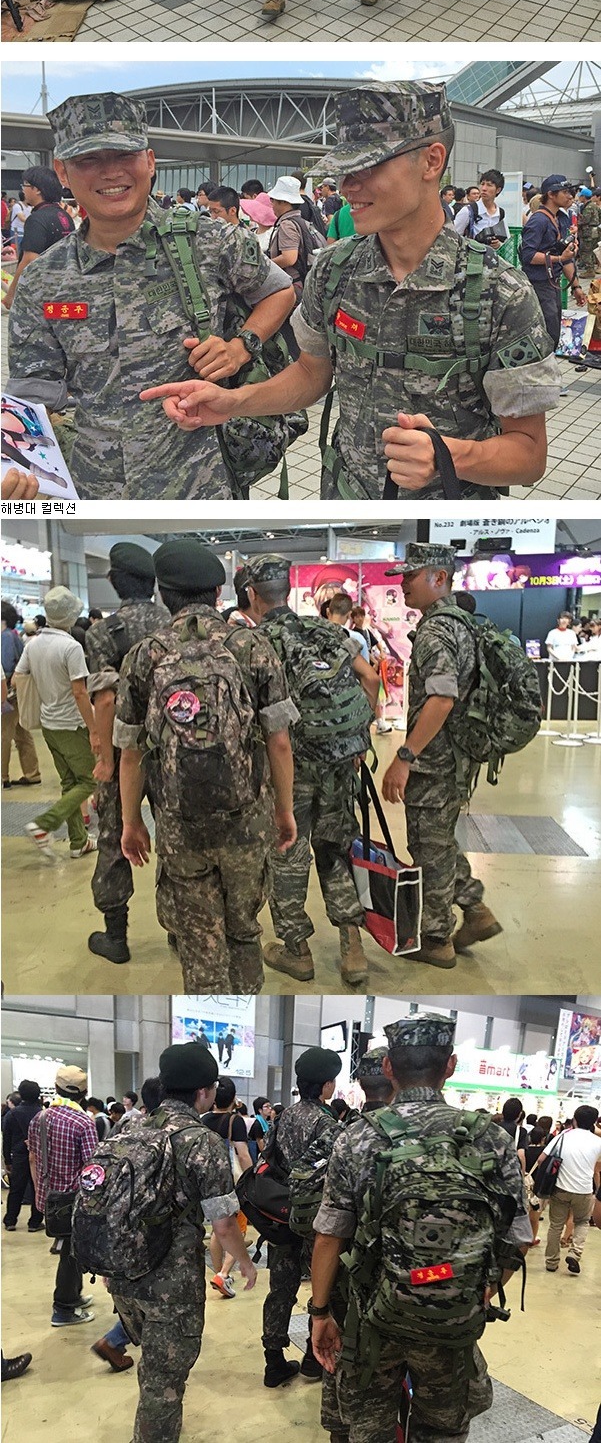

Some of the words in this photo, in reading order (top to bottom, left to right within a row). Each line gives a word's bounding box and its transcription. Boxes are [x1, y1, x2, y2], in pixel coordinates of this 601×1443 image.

[459, 519, 480, 527] 劇場版
[515, 527, 541, 535] Cadenza
